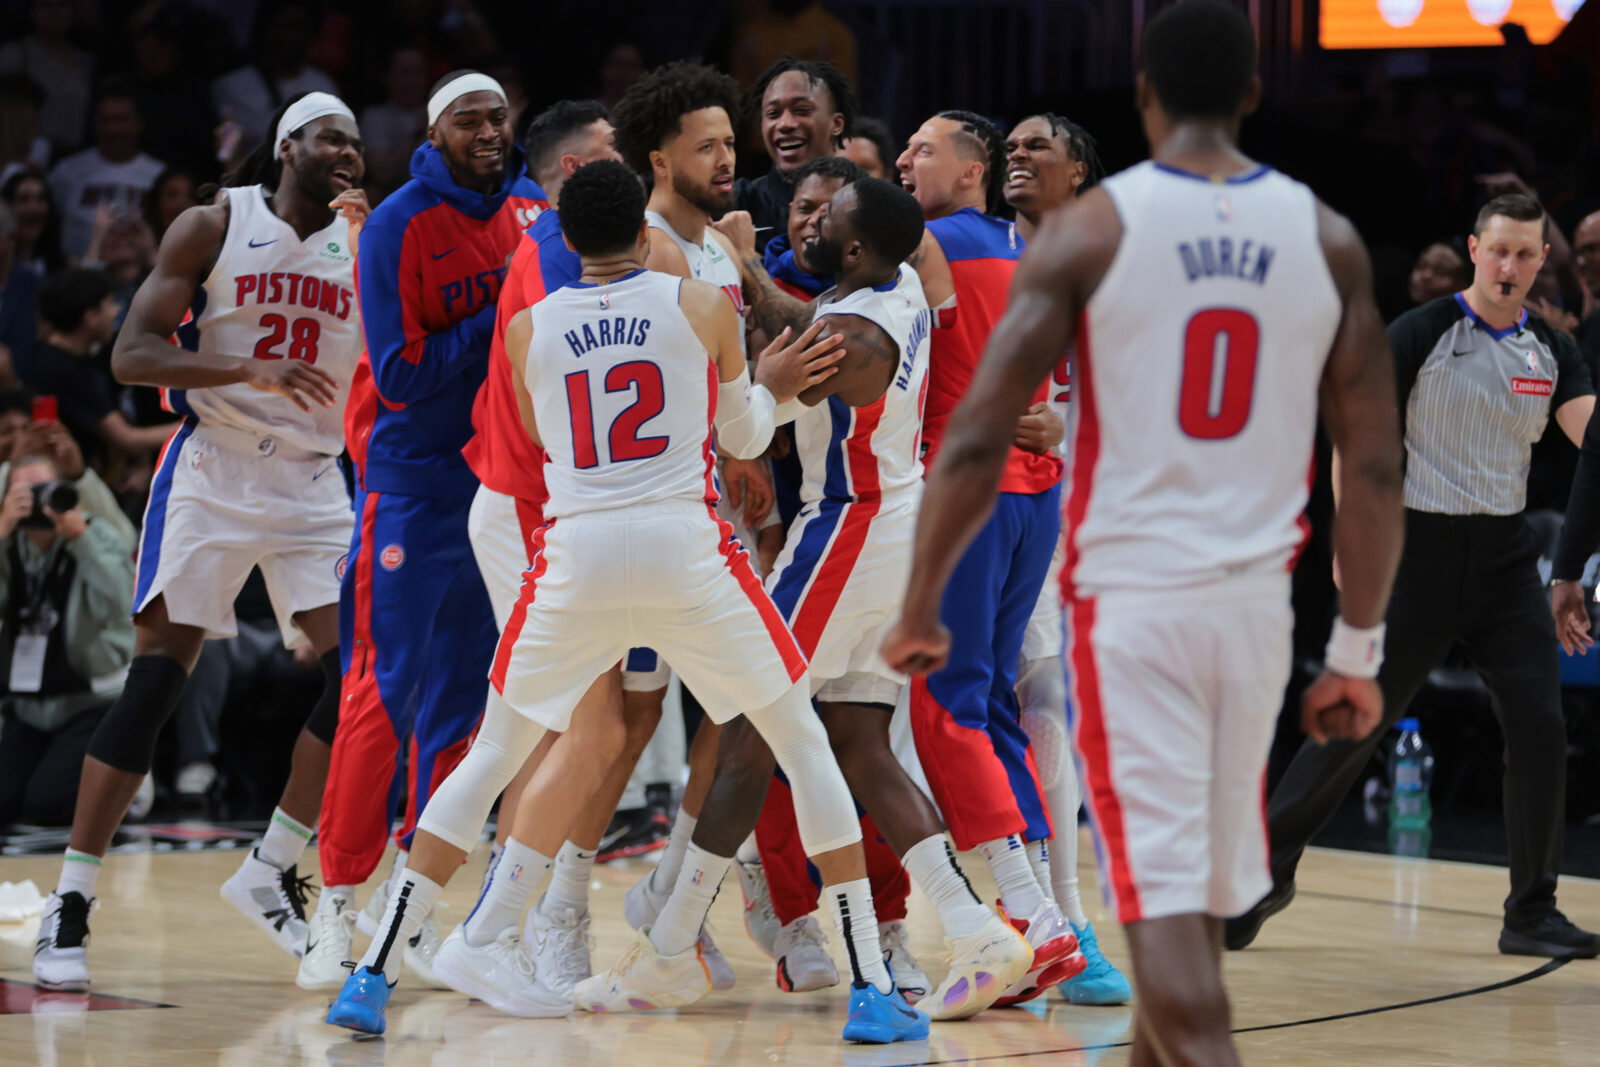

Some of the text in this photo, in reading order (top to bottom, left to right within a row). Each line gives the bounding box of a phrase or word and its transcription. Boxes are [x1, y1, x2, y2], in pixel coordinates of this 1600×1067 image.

[1178, 236, 1275, 285] DUREN
[234, 272, 353, 321] PISTONS
[253, 313, 320, 365] 28
[564, 317, 651, 358] HARRIS
[1178, 305, 1261, 441] 0
[564, 359, 670, 469] 12
